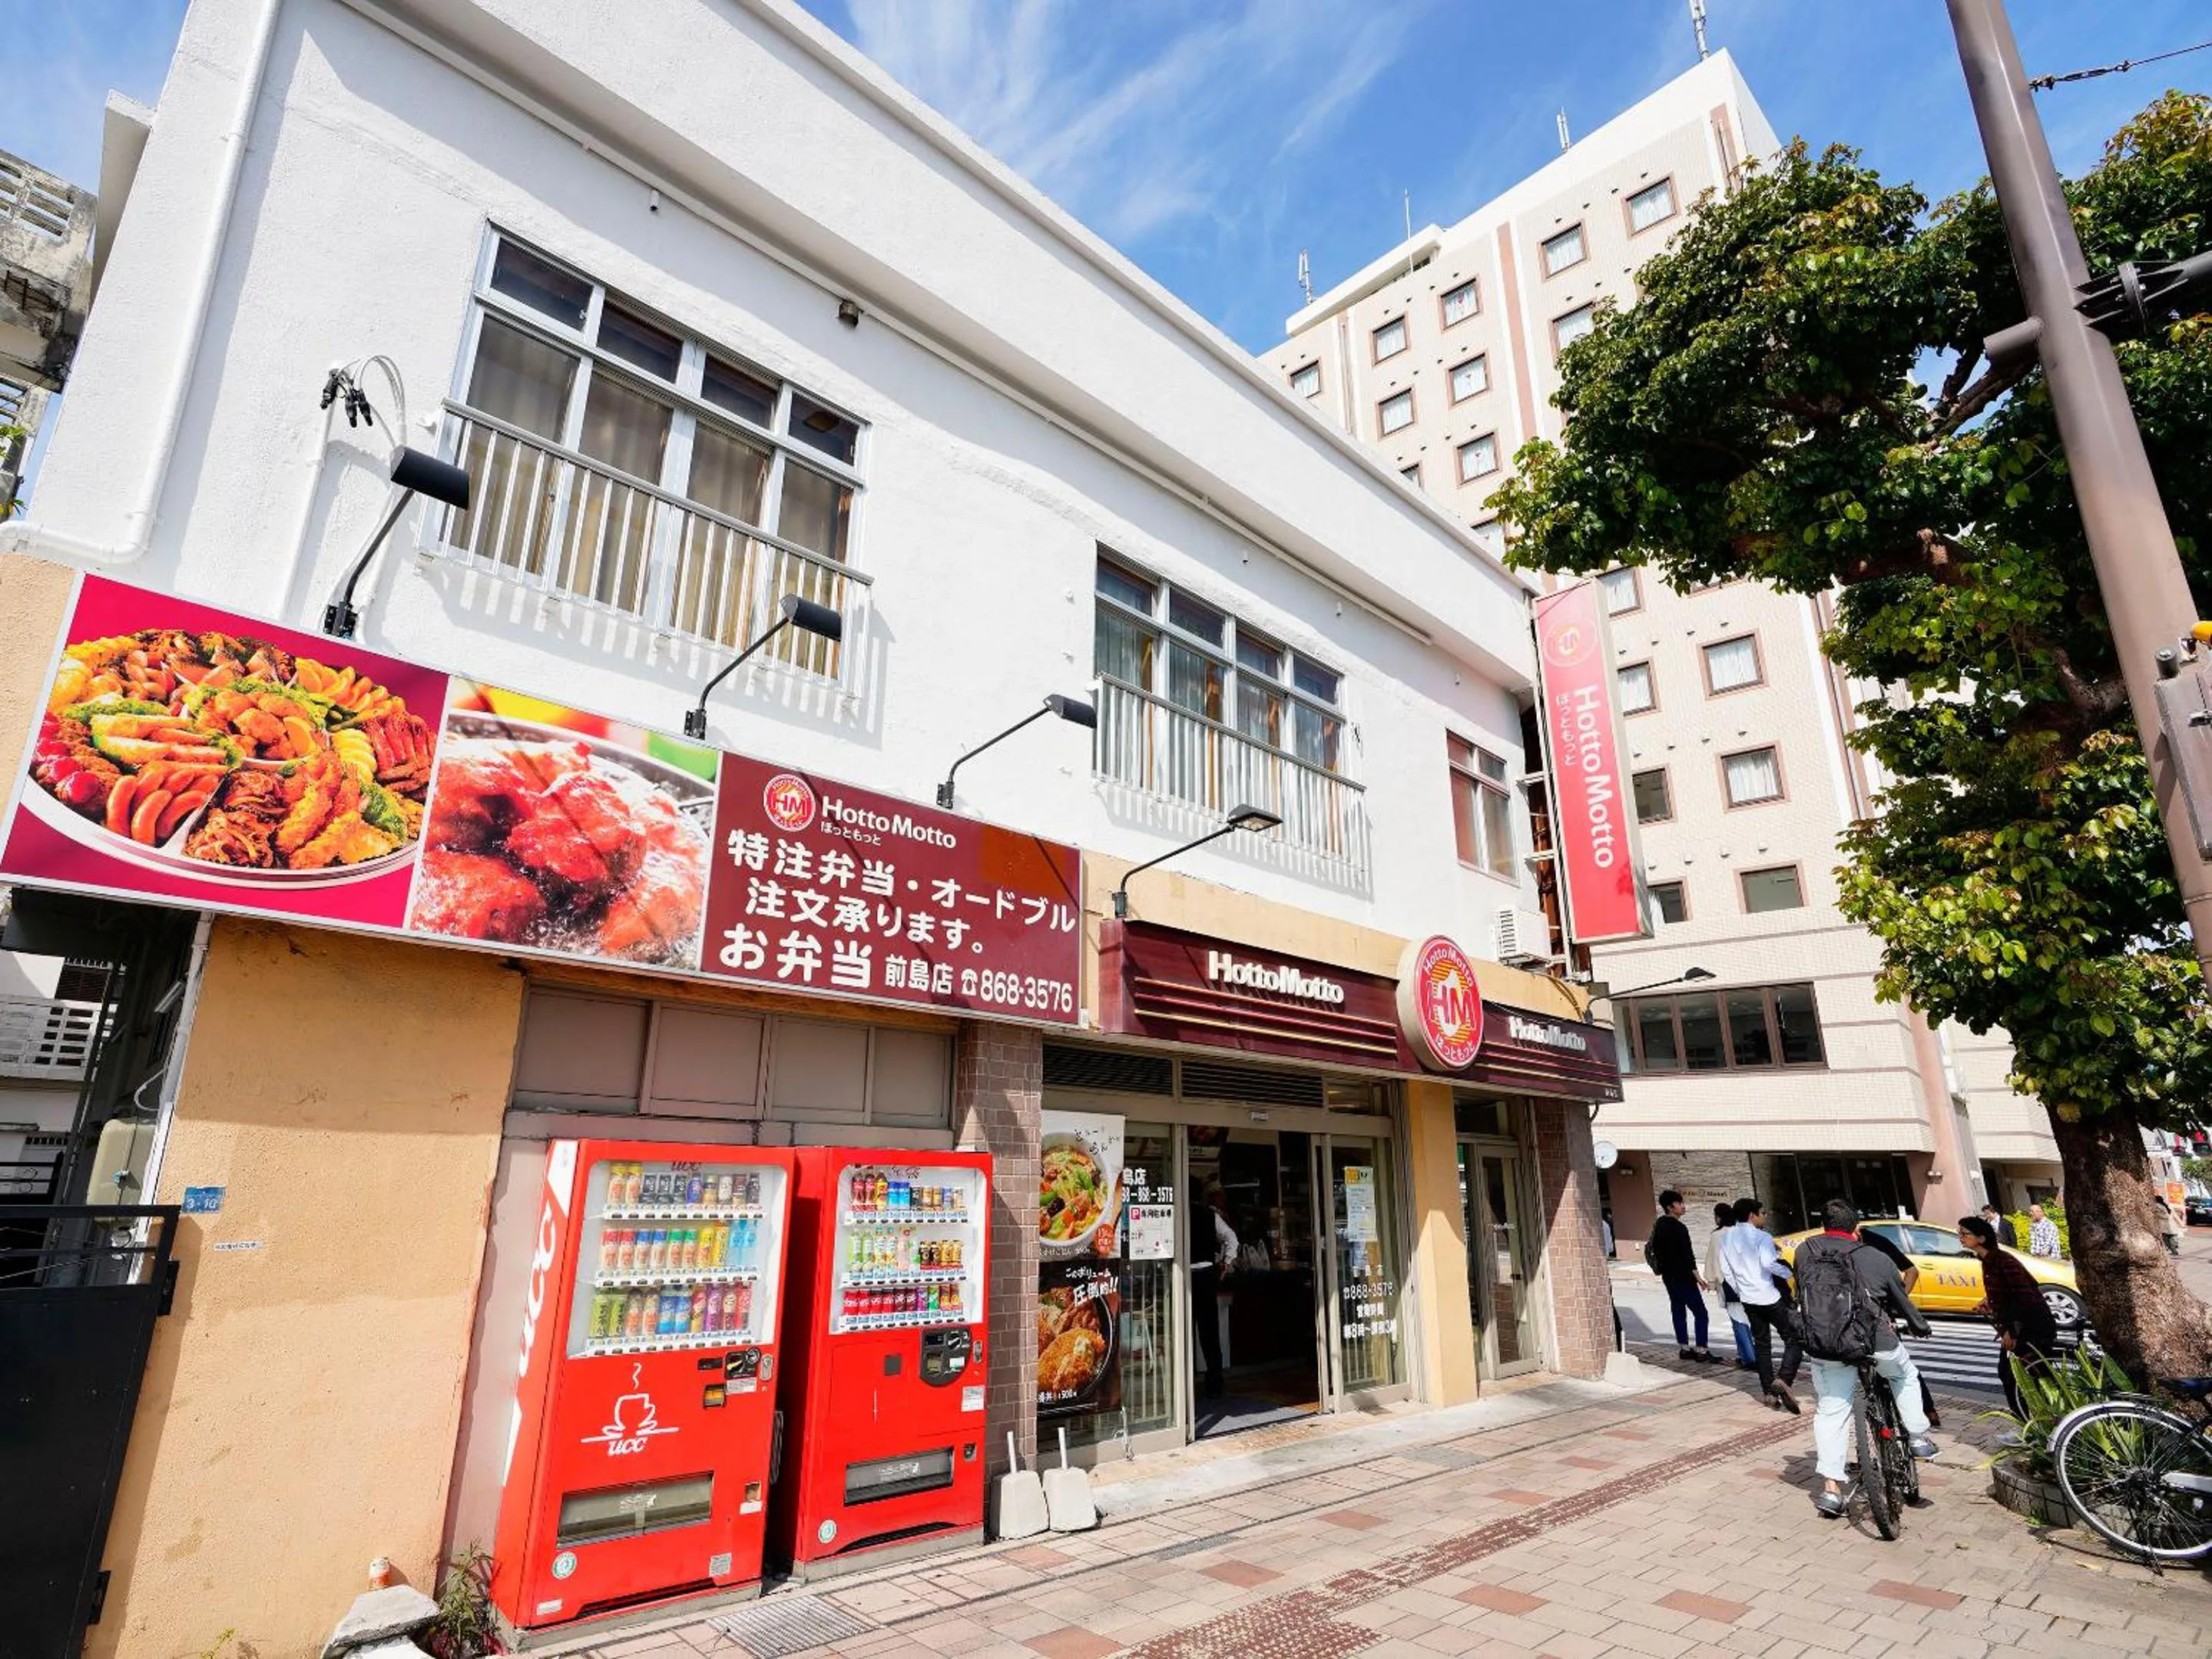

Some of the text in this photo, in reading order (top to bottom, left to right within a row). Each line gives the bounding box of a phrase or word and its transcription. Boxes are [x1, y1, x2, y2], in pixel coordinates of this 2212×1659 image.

[1575, 684, 1614, 868] HottoMotto
[820, 820, 882, 846] ほっともっと
[822, 796, 957, 849] HottoMotto
[727, 830, 1075, 933] 特注弁当・オードブル
[745, 876, 983, 954] 注文承ります。
[719, 922, 1073, 1013] お弁当 前島店 868-3576
[1208, 950, 1344, 1003] HottoMotto
[1509, 1015, 1586, 1051] HottoMotto
[1936, 1273, 1979, 1287] TAXI
